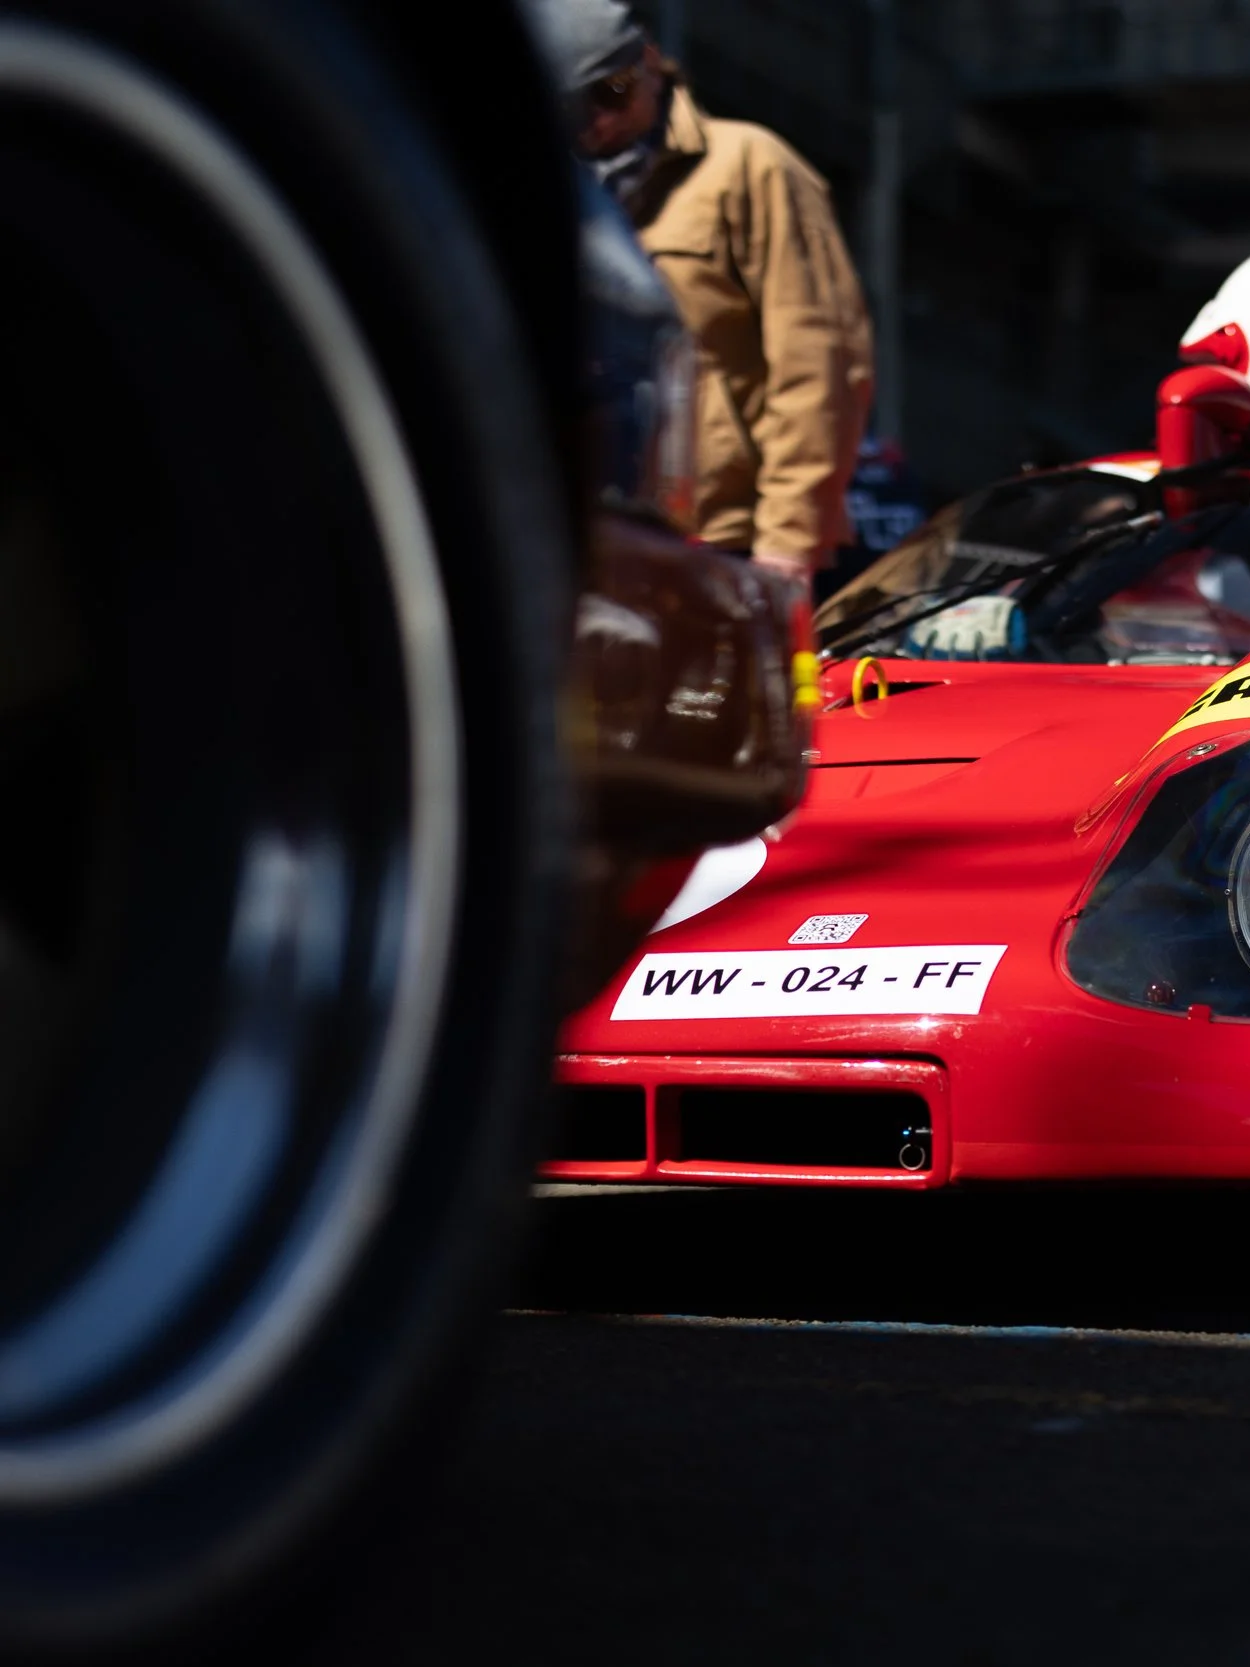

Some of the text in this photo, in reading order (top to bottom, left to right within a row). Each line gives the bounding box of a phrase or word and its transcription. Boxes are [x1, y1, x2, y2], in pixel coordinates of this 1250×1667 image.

[642, 968, 740, 996] WW
[781, 965, 869, 993] 024
[913, 961, 982, 989] FF
